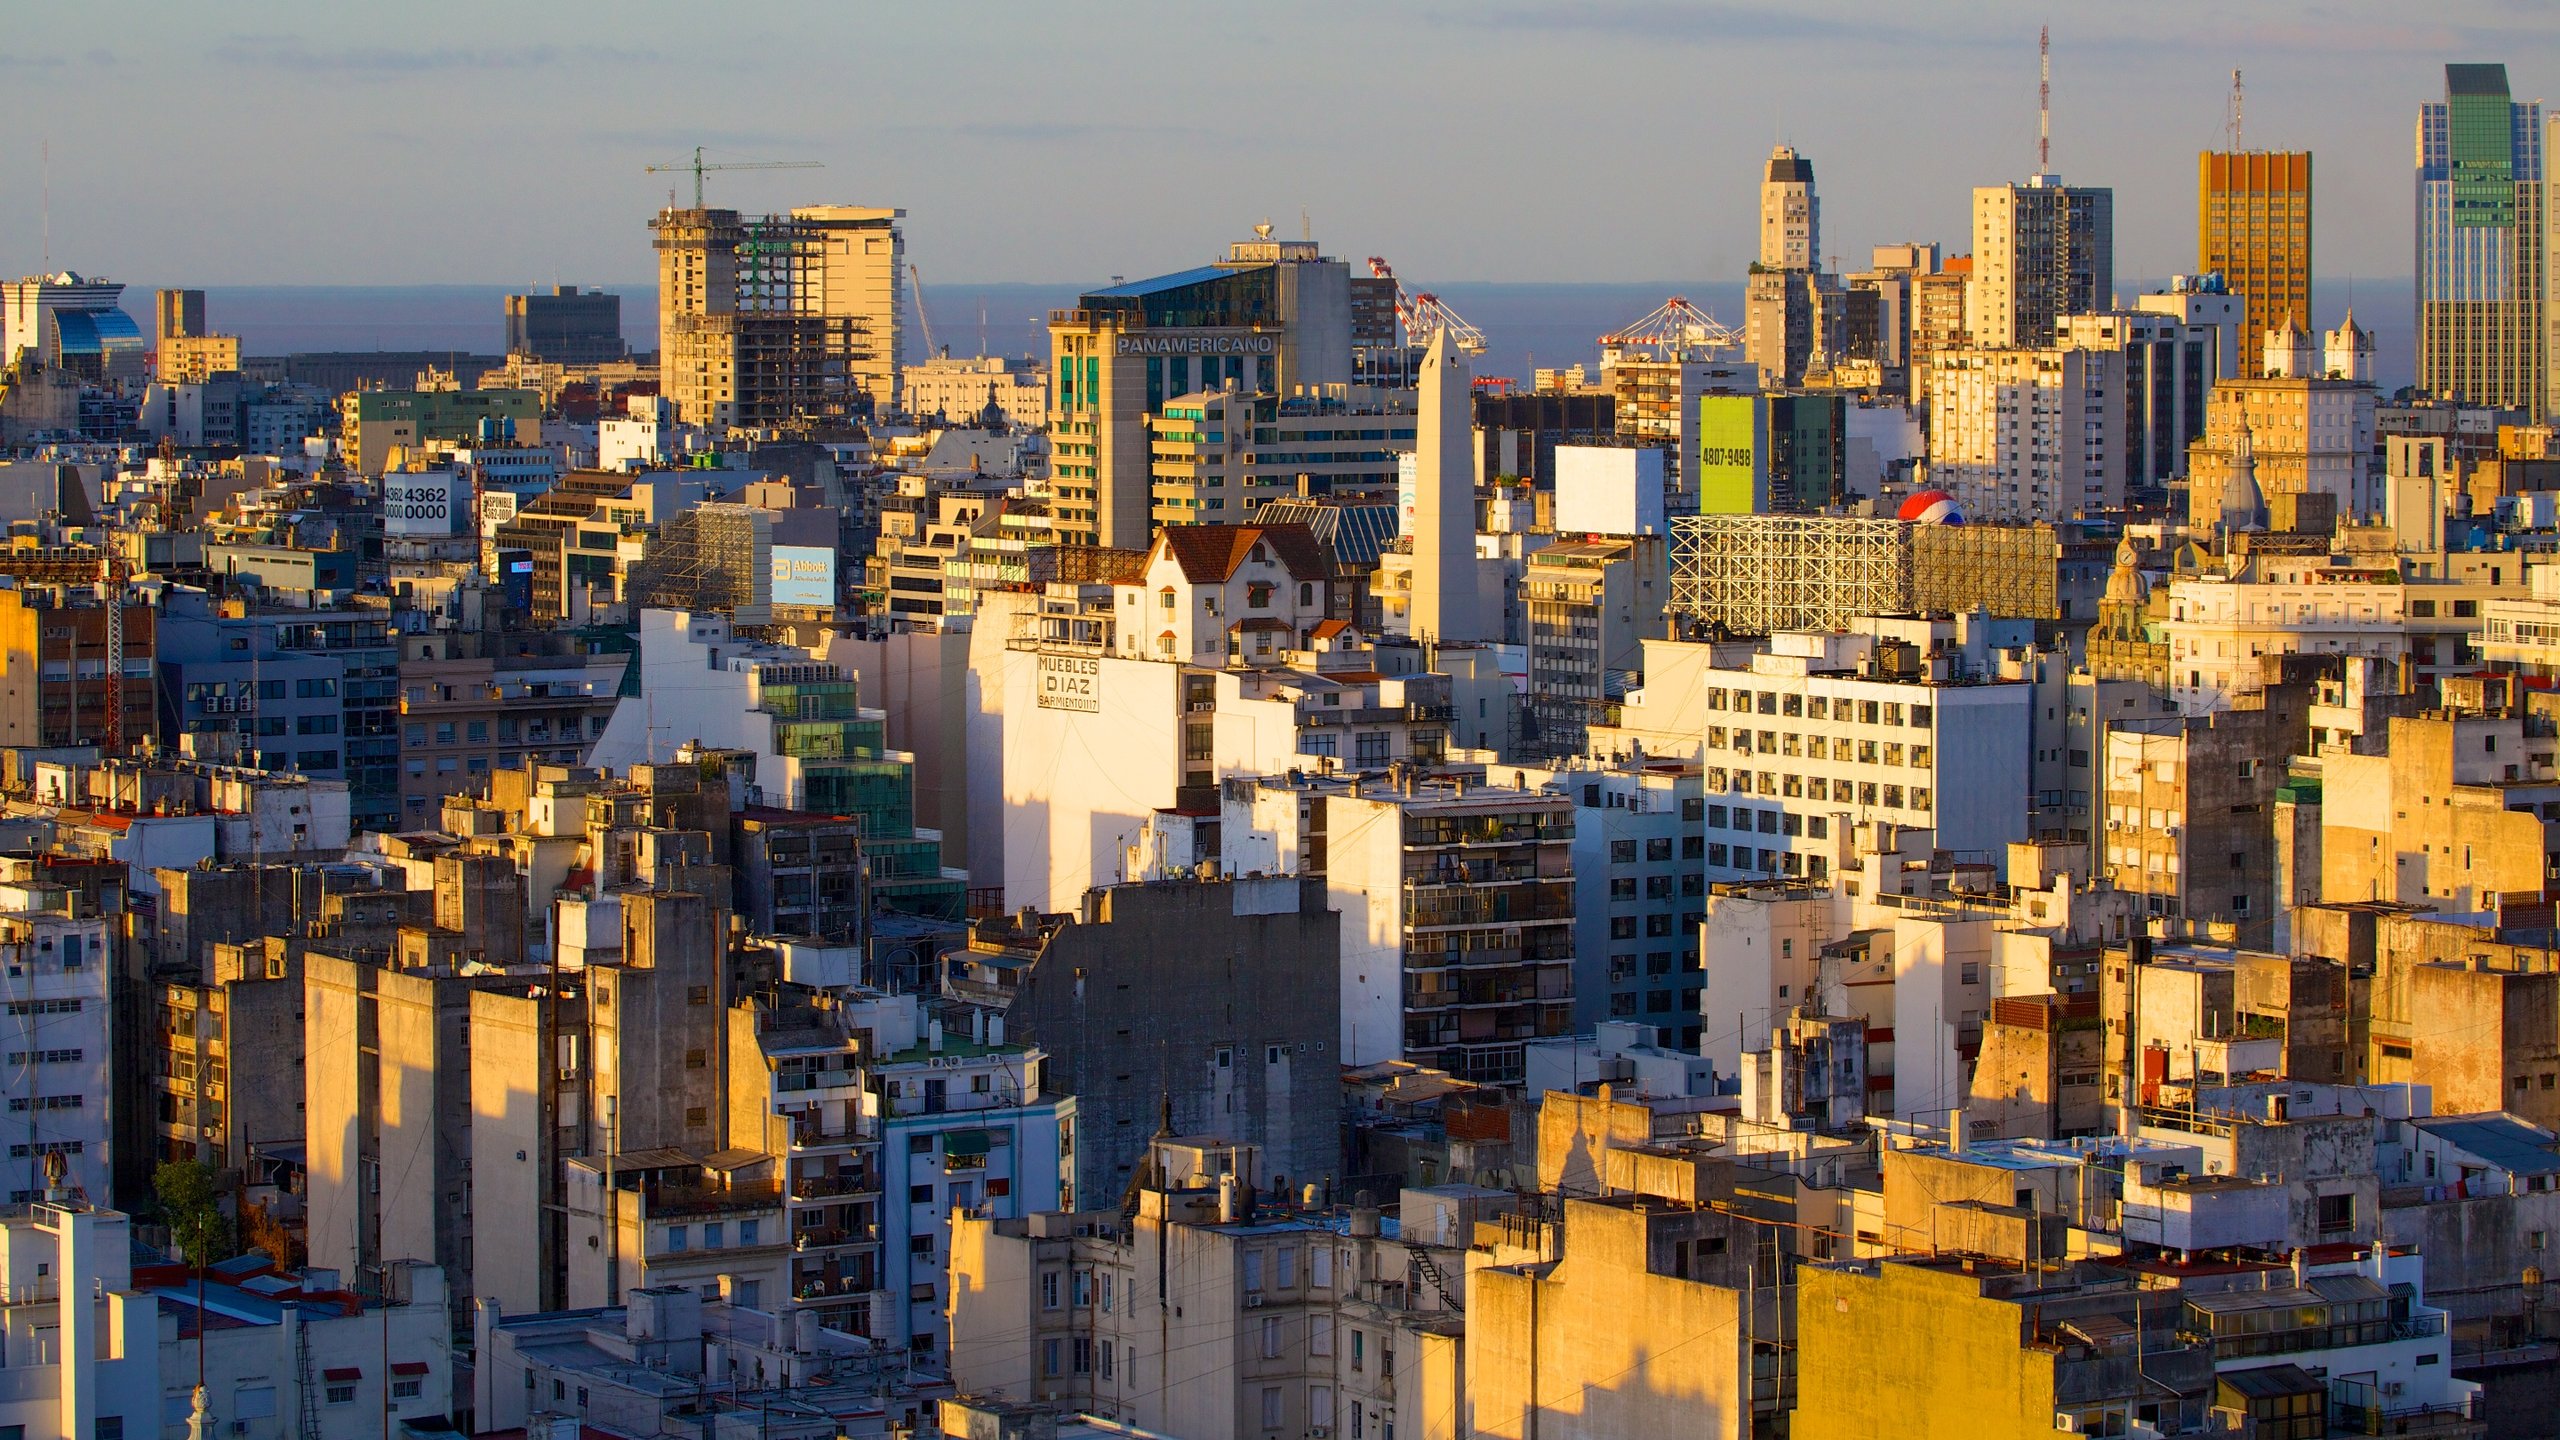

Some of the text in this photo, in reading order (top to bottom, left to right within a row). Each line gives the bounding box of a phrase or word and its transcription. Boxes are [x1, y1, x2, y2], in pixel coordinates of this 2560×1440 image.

[1117, 336, 1272, 353] PANAMERICANO
[1703, 448, 1751, 467] 4807-9498
[385, 487, 403, 502] 4362
[405, 488, 446, 502] 4362
[385, 504, 403, 519] 0000
[405, 505, 446, 519] 0000
[794, 560, 828, 573] Abbott
[1039, 657, 1098, 675] MUEBLES
[1047, 676, 1090, 695] DIAZ
